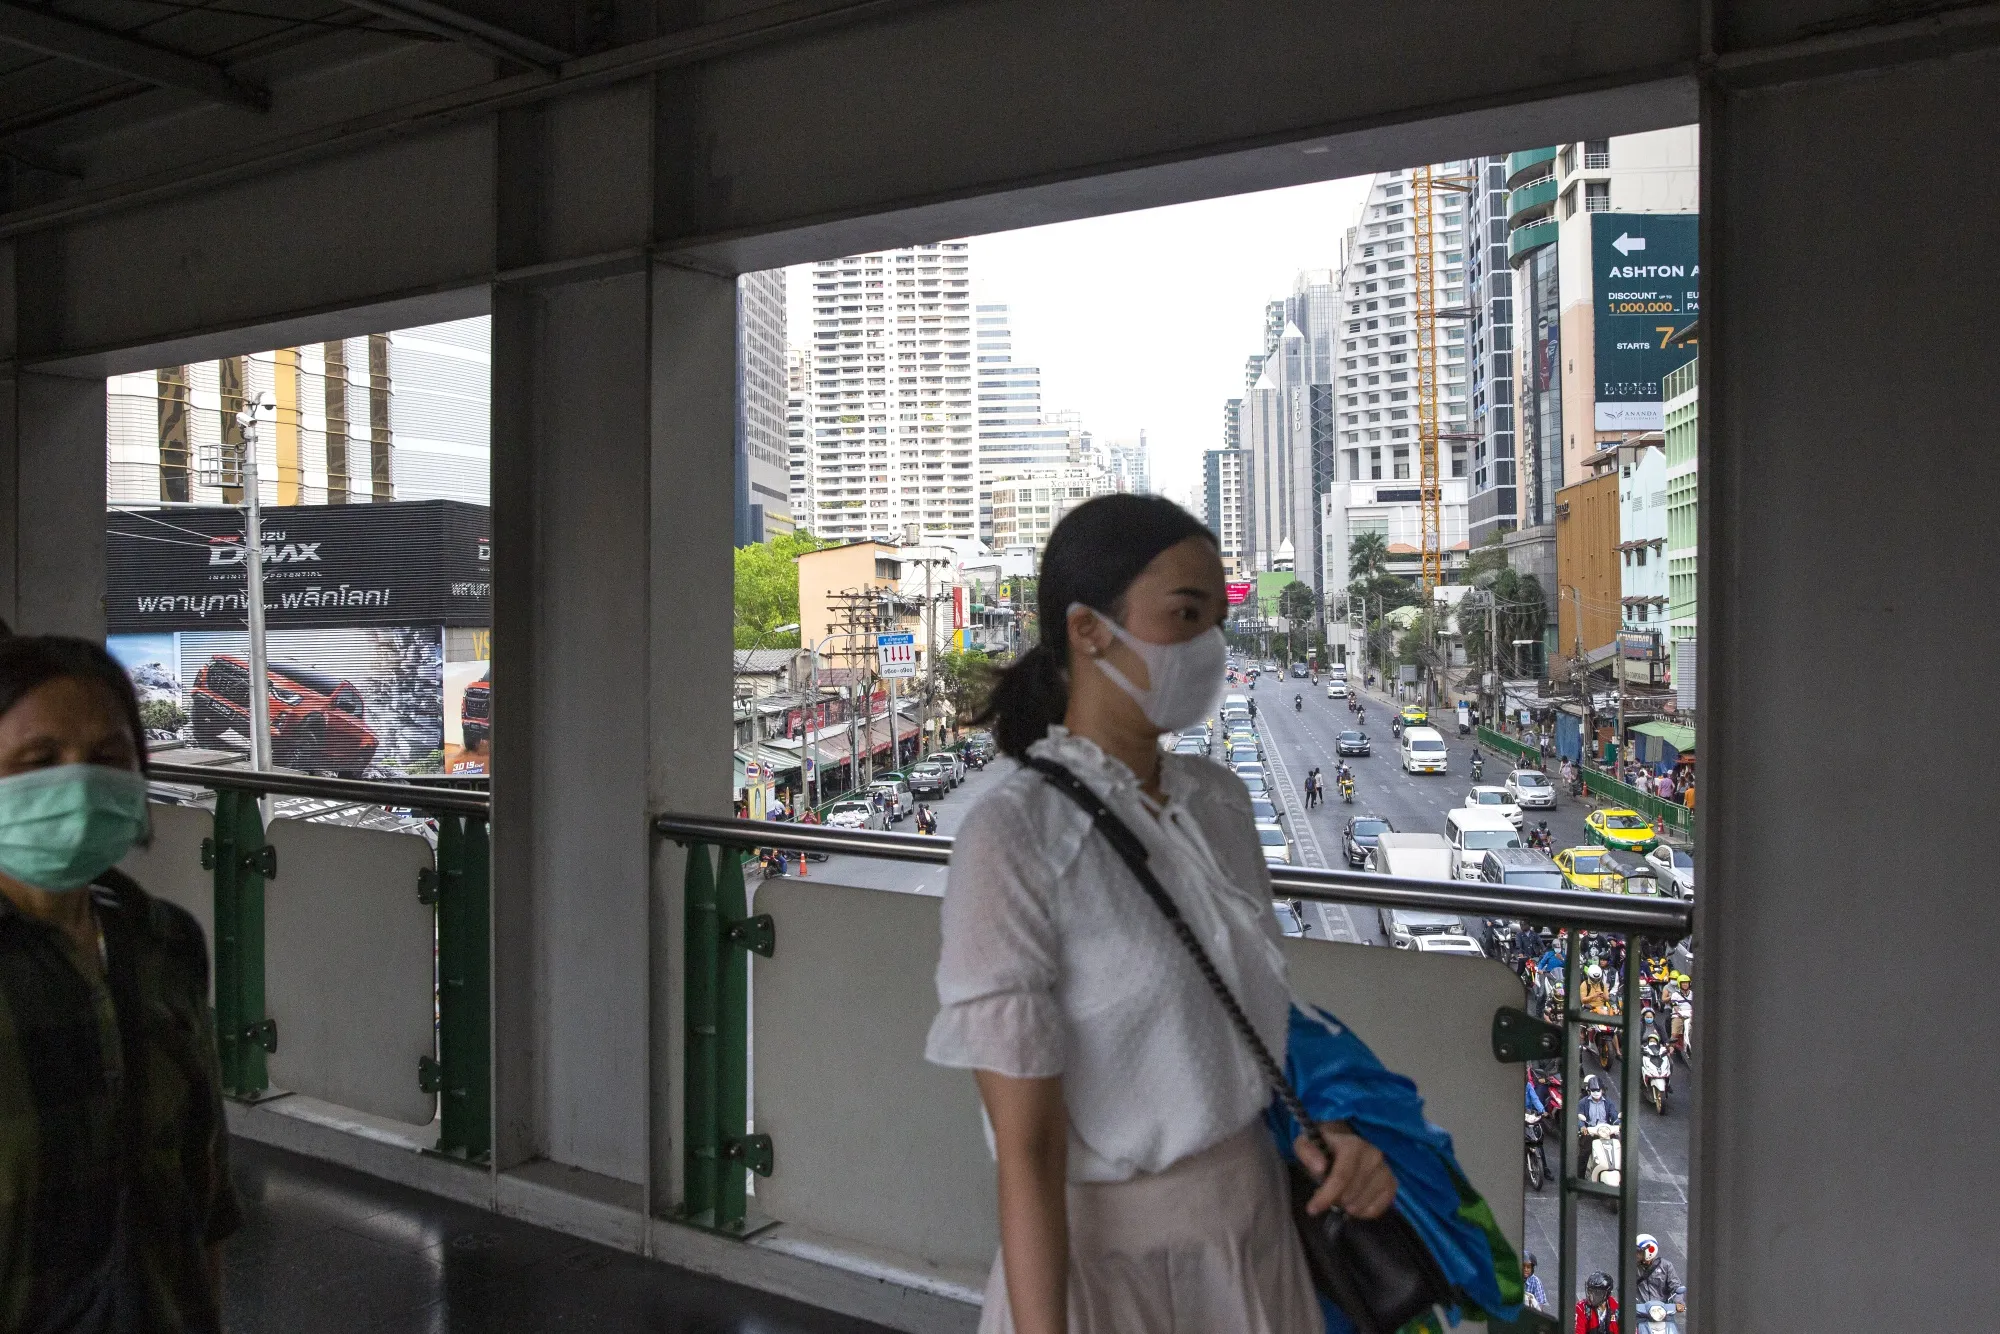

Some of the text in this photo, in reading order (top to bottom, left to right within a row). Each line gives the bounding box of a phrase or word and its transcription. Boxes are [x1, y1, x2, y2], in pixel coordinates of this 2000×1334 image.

[1608, 265, 1685, 278] ASHTON
[1608, 292, 1658, 300] DISCOUNT
[1608, 302, 1673, 314] 1,000,000
[1616, 342, 1650, 350] STARTS
[1604, 382, 1657, 395] LUXE
